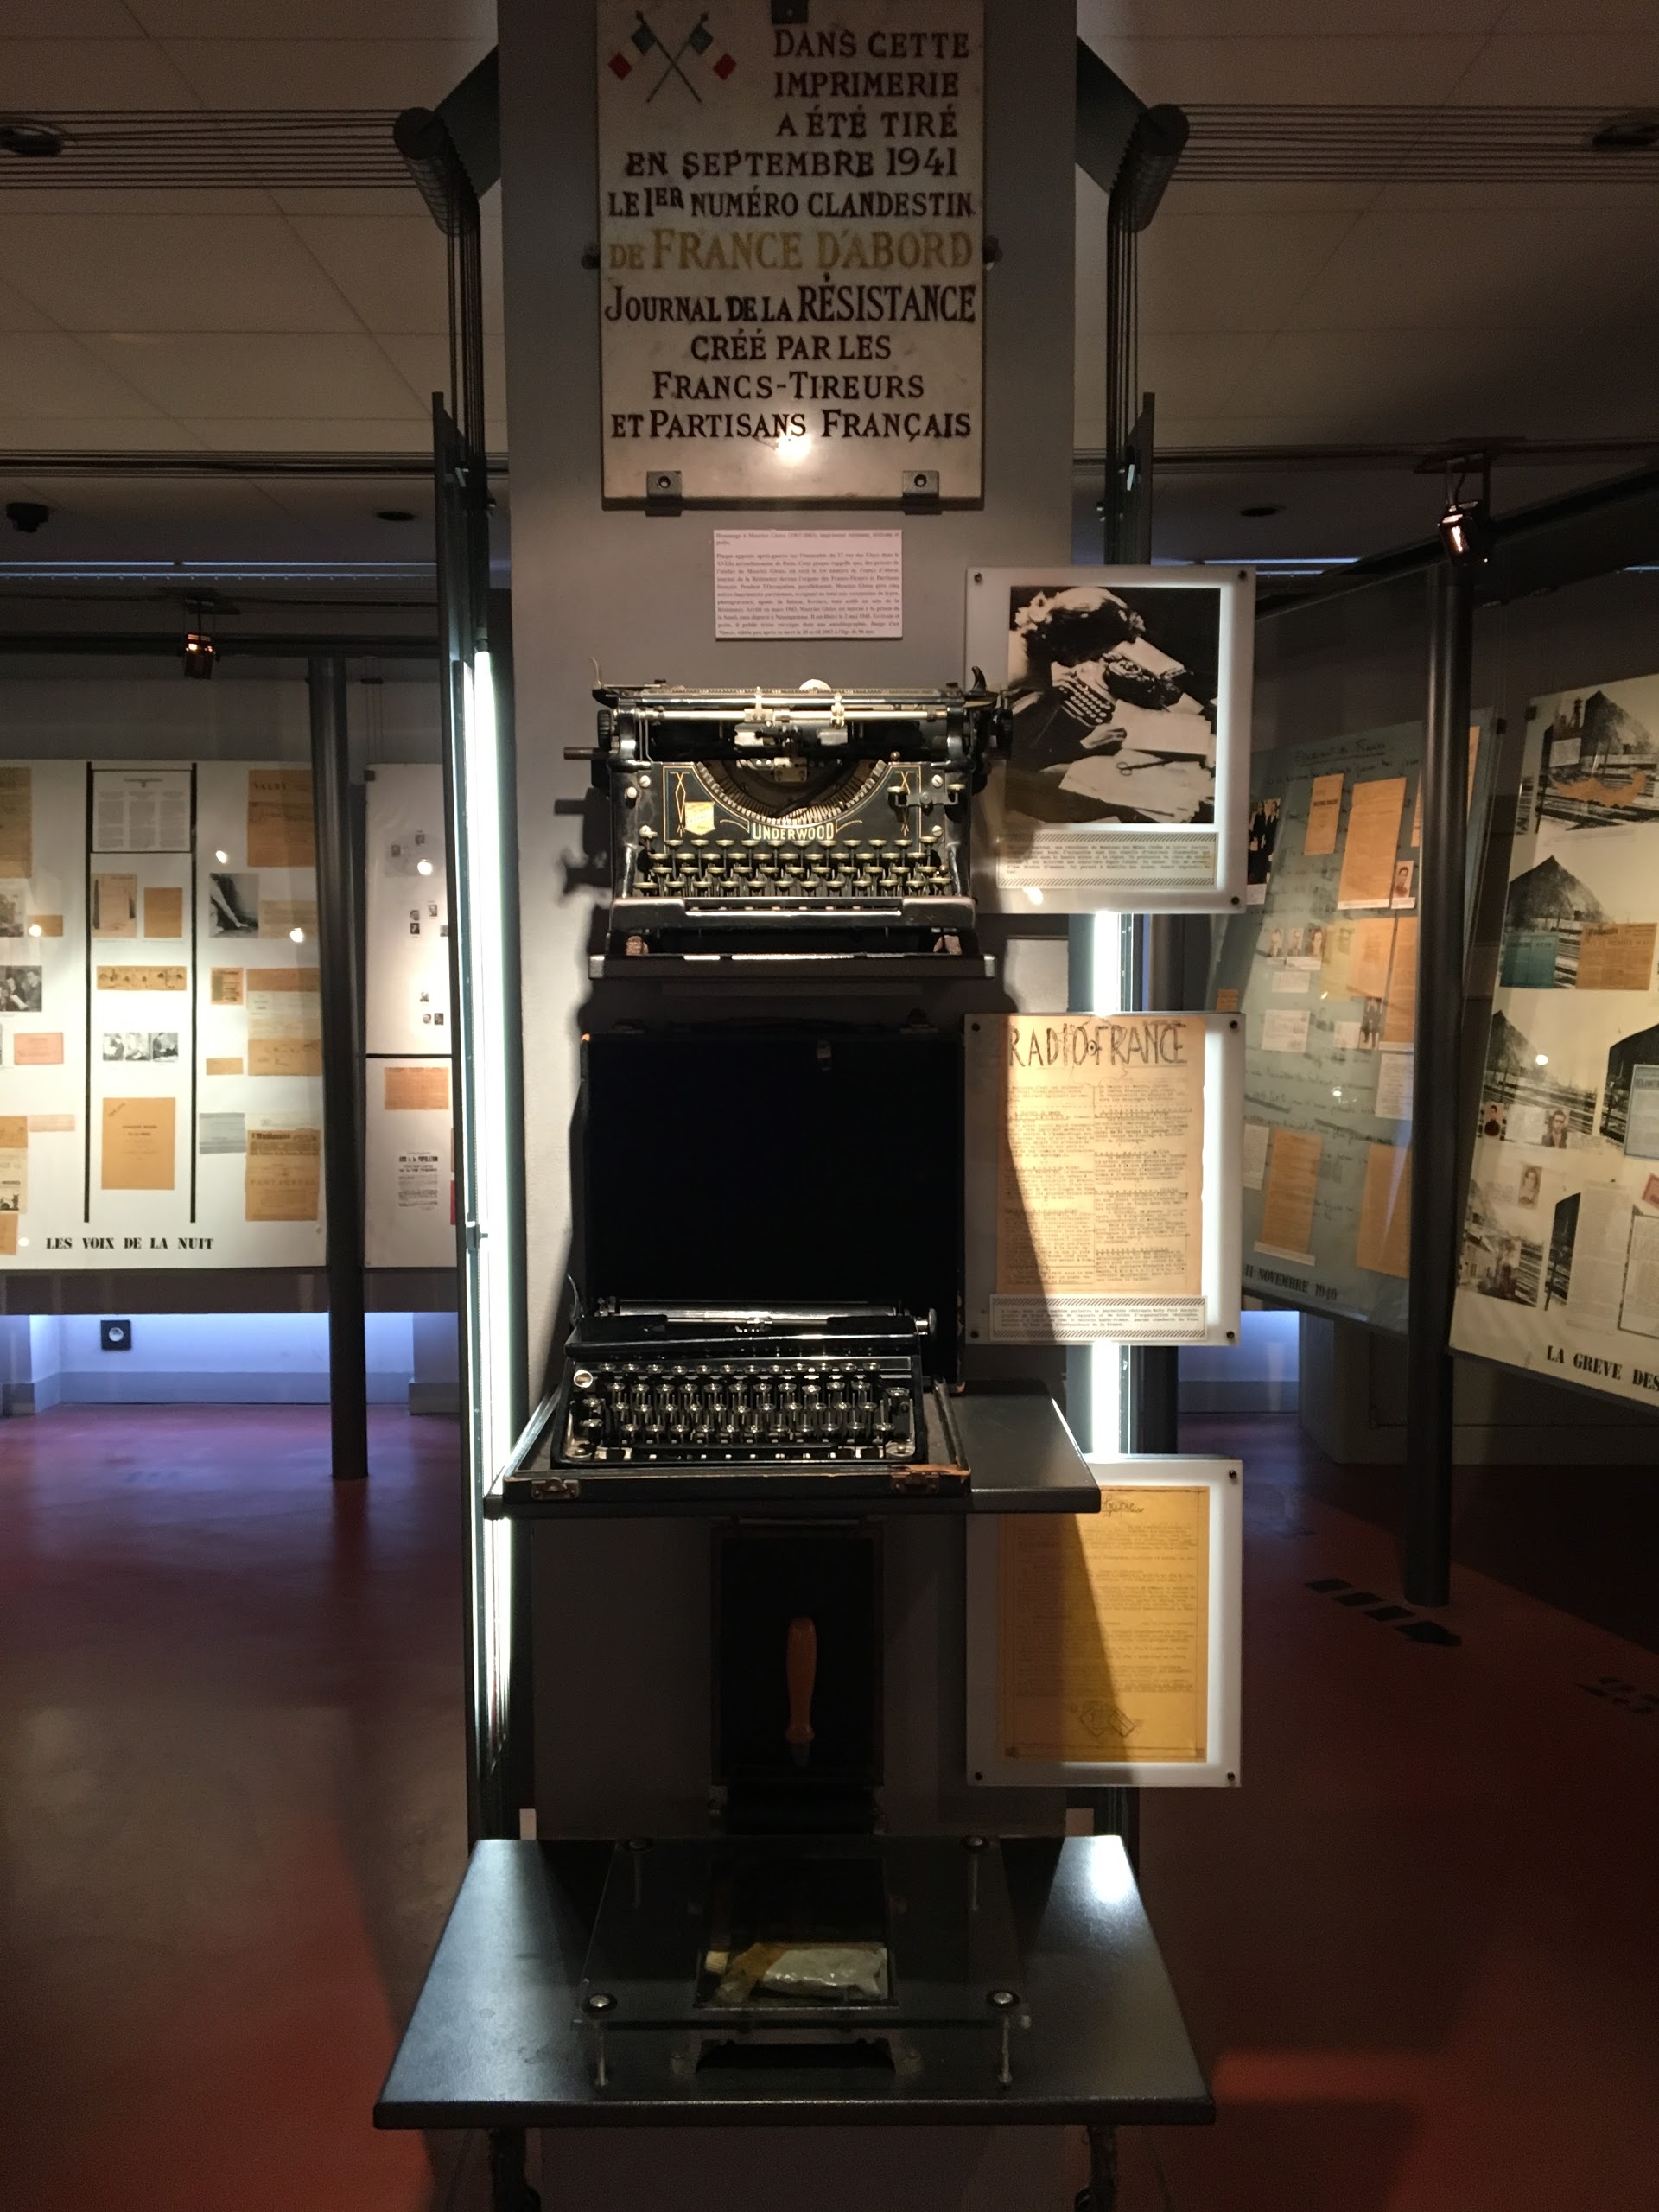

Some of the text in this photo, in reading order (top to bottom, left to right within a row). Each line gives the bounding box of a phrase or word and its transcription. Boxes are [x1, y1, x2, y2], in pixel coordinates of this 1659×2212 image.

[775, 29, 969, 59] DANS CETTE
[775, 71, 958, 98] IMPRIMERIE
[777, 105, 958, 138] A ÉTÉ TIRÉ
[626, 147, 957, 179] EN SEPTEMBRE 1941
[608, 191, 639, 218] LE
[691, 185, 799, 218] NUMÉRO
[807, 192, 976, 218] CLANDESTIN
[610, 227, 973, 270] DE FRANCE D'ABORD
[605, 273, 976, 323] JOURNAL DE LA RÉSISTANCE
[691, 327, 891, 361] CRÉÉ PAR LES
[611, 409, 972, 442] ET PARTISANS FRANÇAIS
[752, 822, 836, 841] UNDERWOOD
[1095, 1020, 1188, 1066] FRANCE
[46, 1237, 214, 1250] LES VOIX DE LA NUIT
[1258, 1268, 1309, 1294] NOVEMBRE
[1315, 1283, 1338, 1300] 1940
[1547, 1344, 1565, 1364] LA
[1573, 1352, 1623, 1381] GREVE
